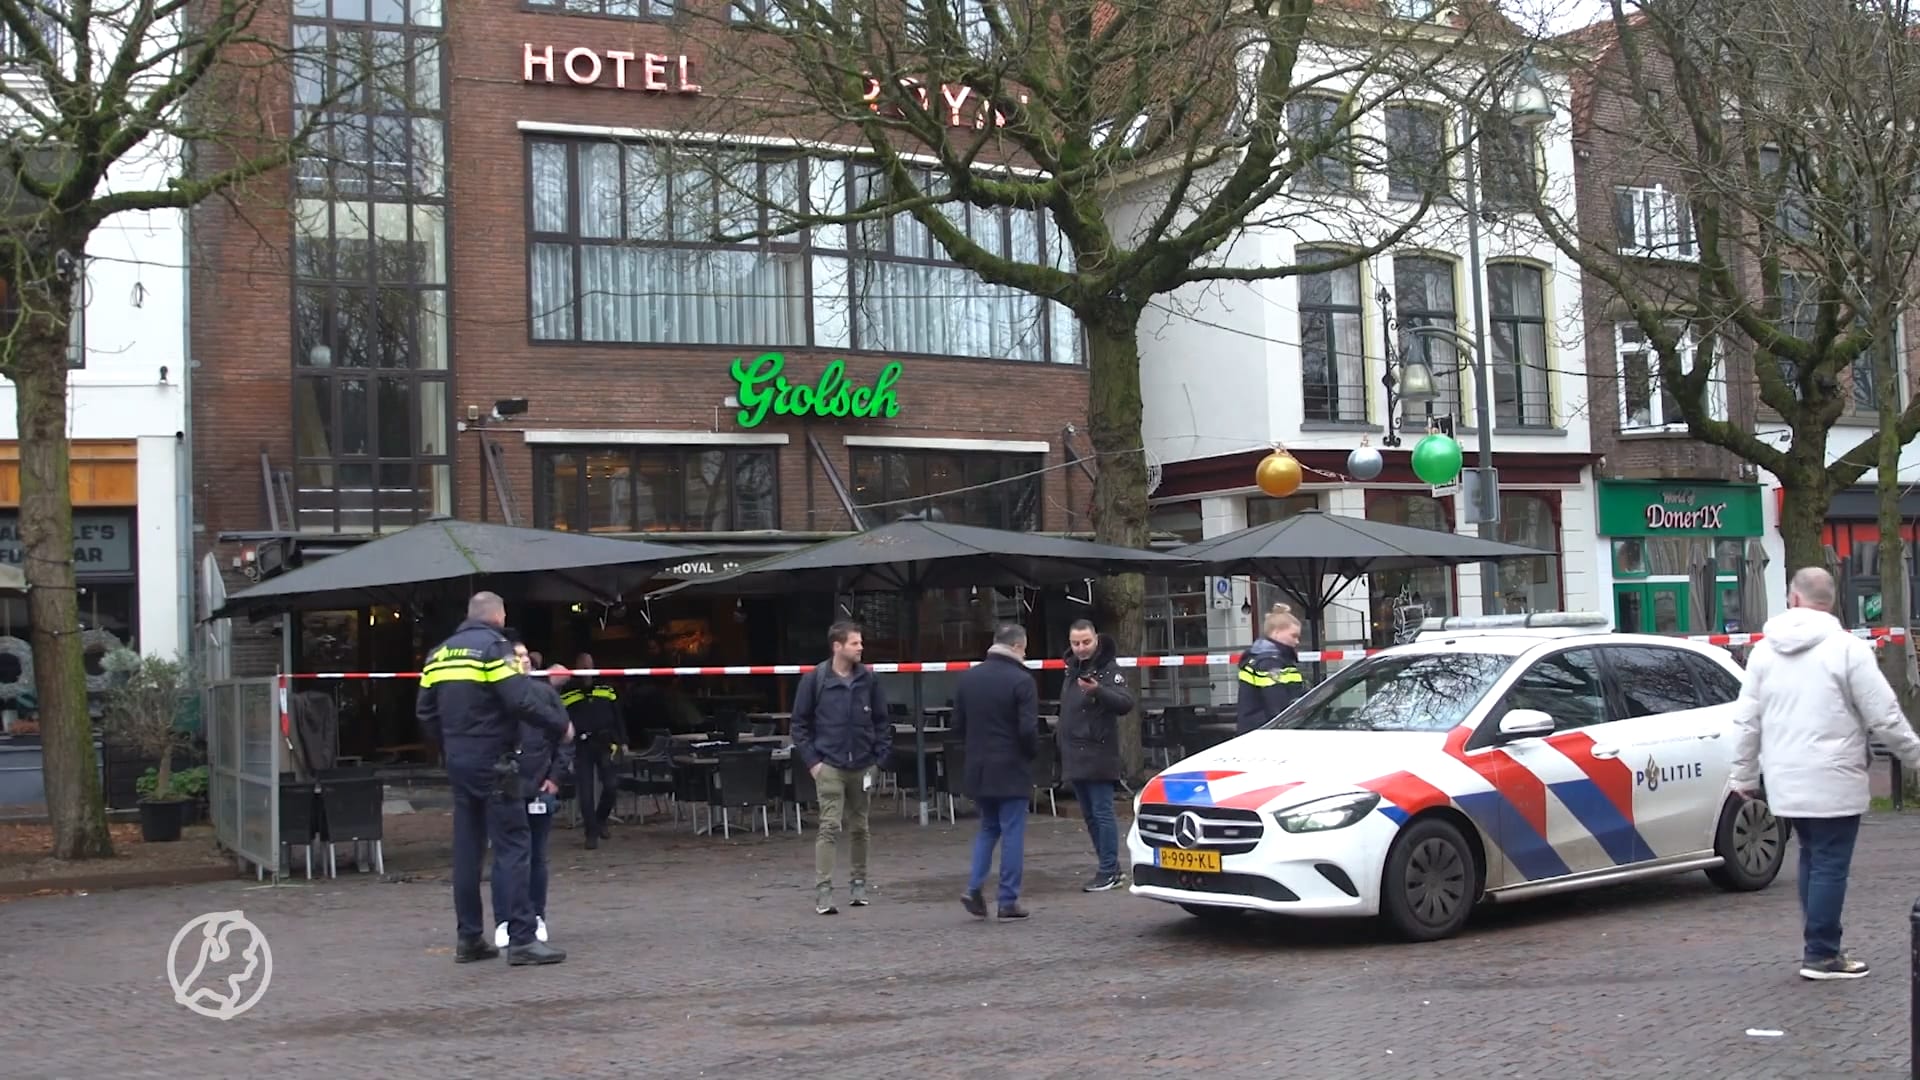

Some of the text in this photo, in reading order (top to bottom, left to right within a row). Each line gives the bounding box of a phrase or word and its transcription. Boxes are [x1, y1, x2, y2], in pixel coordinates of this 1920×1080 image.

[524, 43, 702, 92] HOTEL
[730, 352, 902, 428] Grolsch
[673, 562, 715, 574] ROYAL
[1636, 761, 1702, 791] POLITIE
[1161, 850, 1215, 869] R-999-KL
